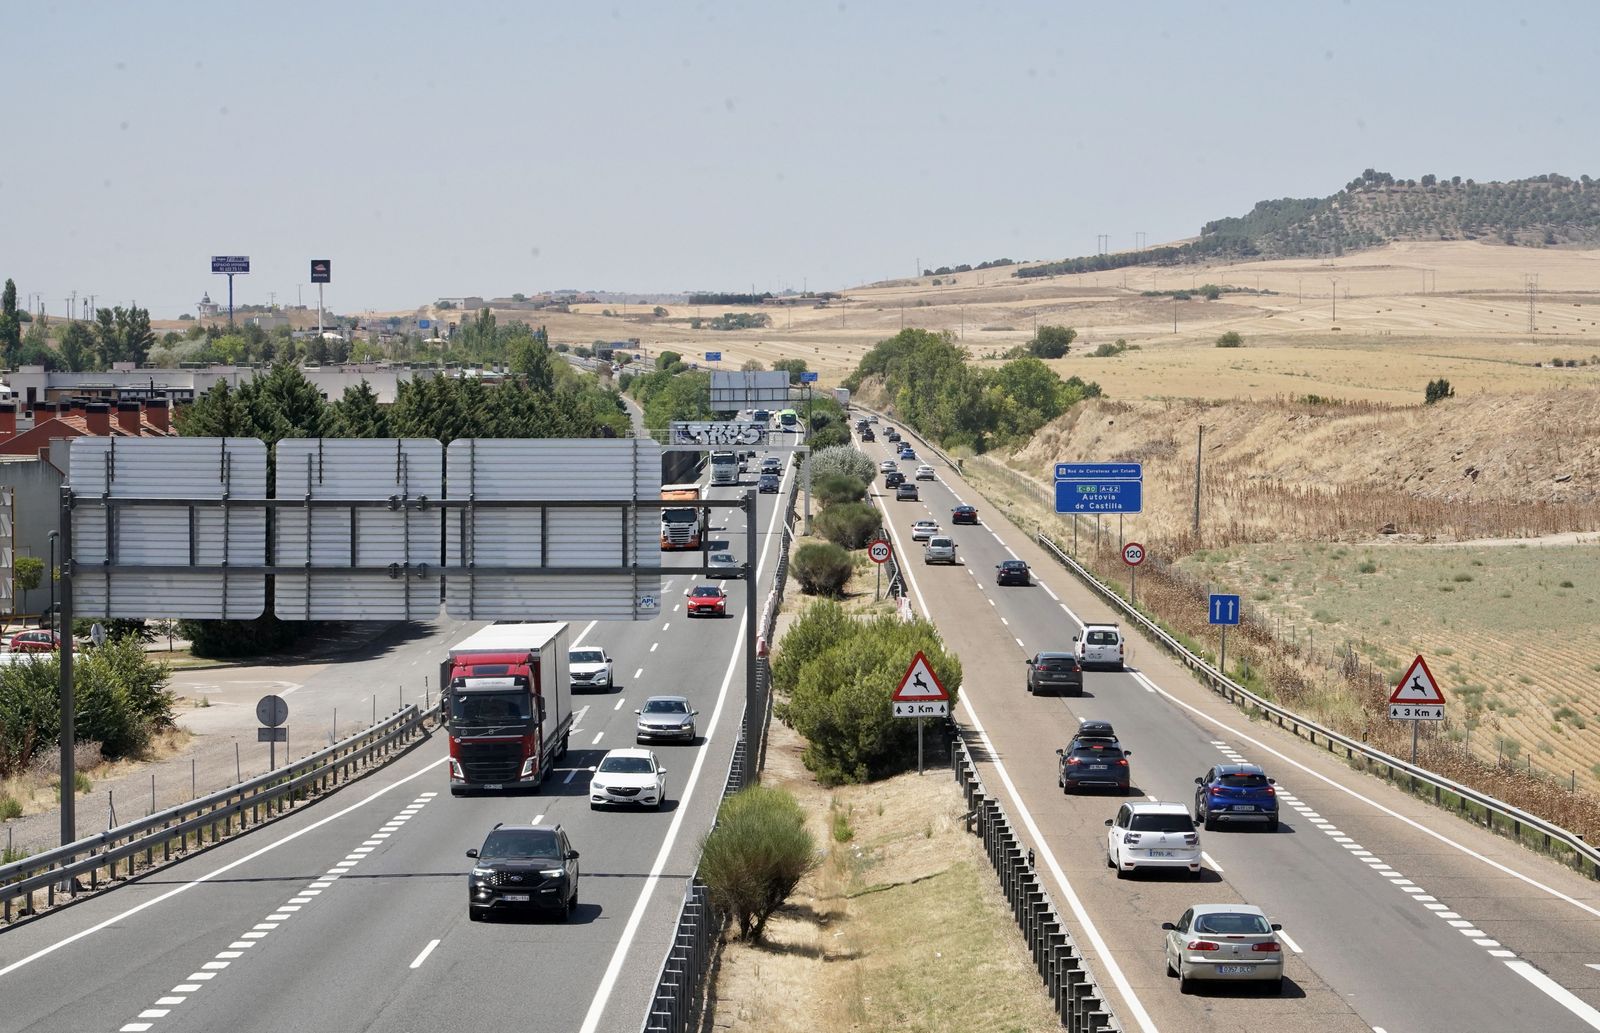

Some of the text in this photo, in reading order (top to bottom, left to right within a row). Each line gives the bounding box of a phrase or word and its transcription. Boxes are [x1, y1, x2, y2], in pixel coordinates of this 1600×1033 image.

[872, 547, 888, 556] 120
[1126, 550, 1142, 559] 120
[907, 705, 934, 714] 3 Km
[1404, 708, 1430, 717] 3 Km
